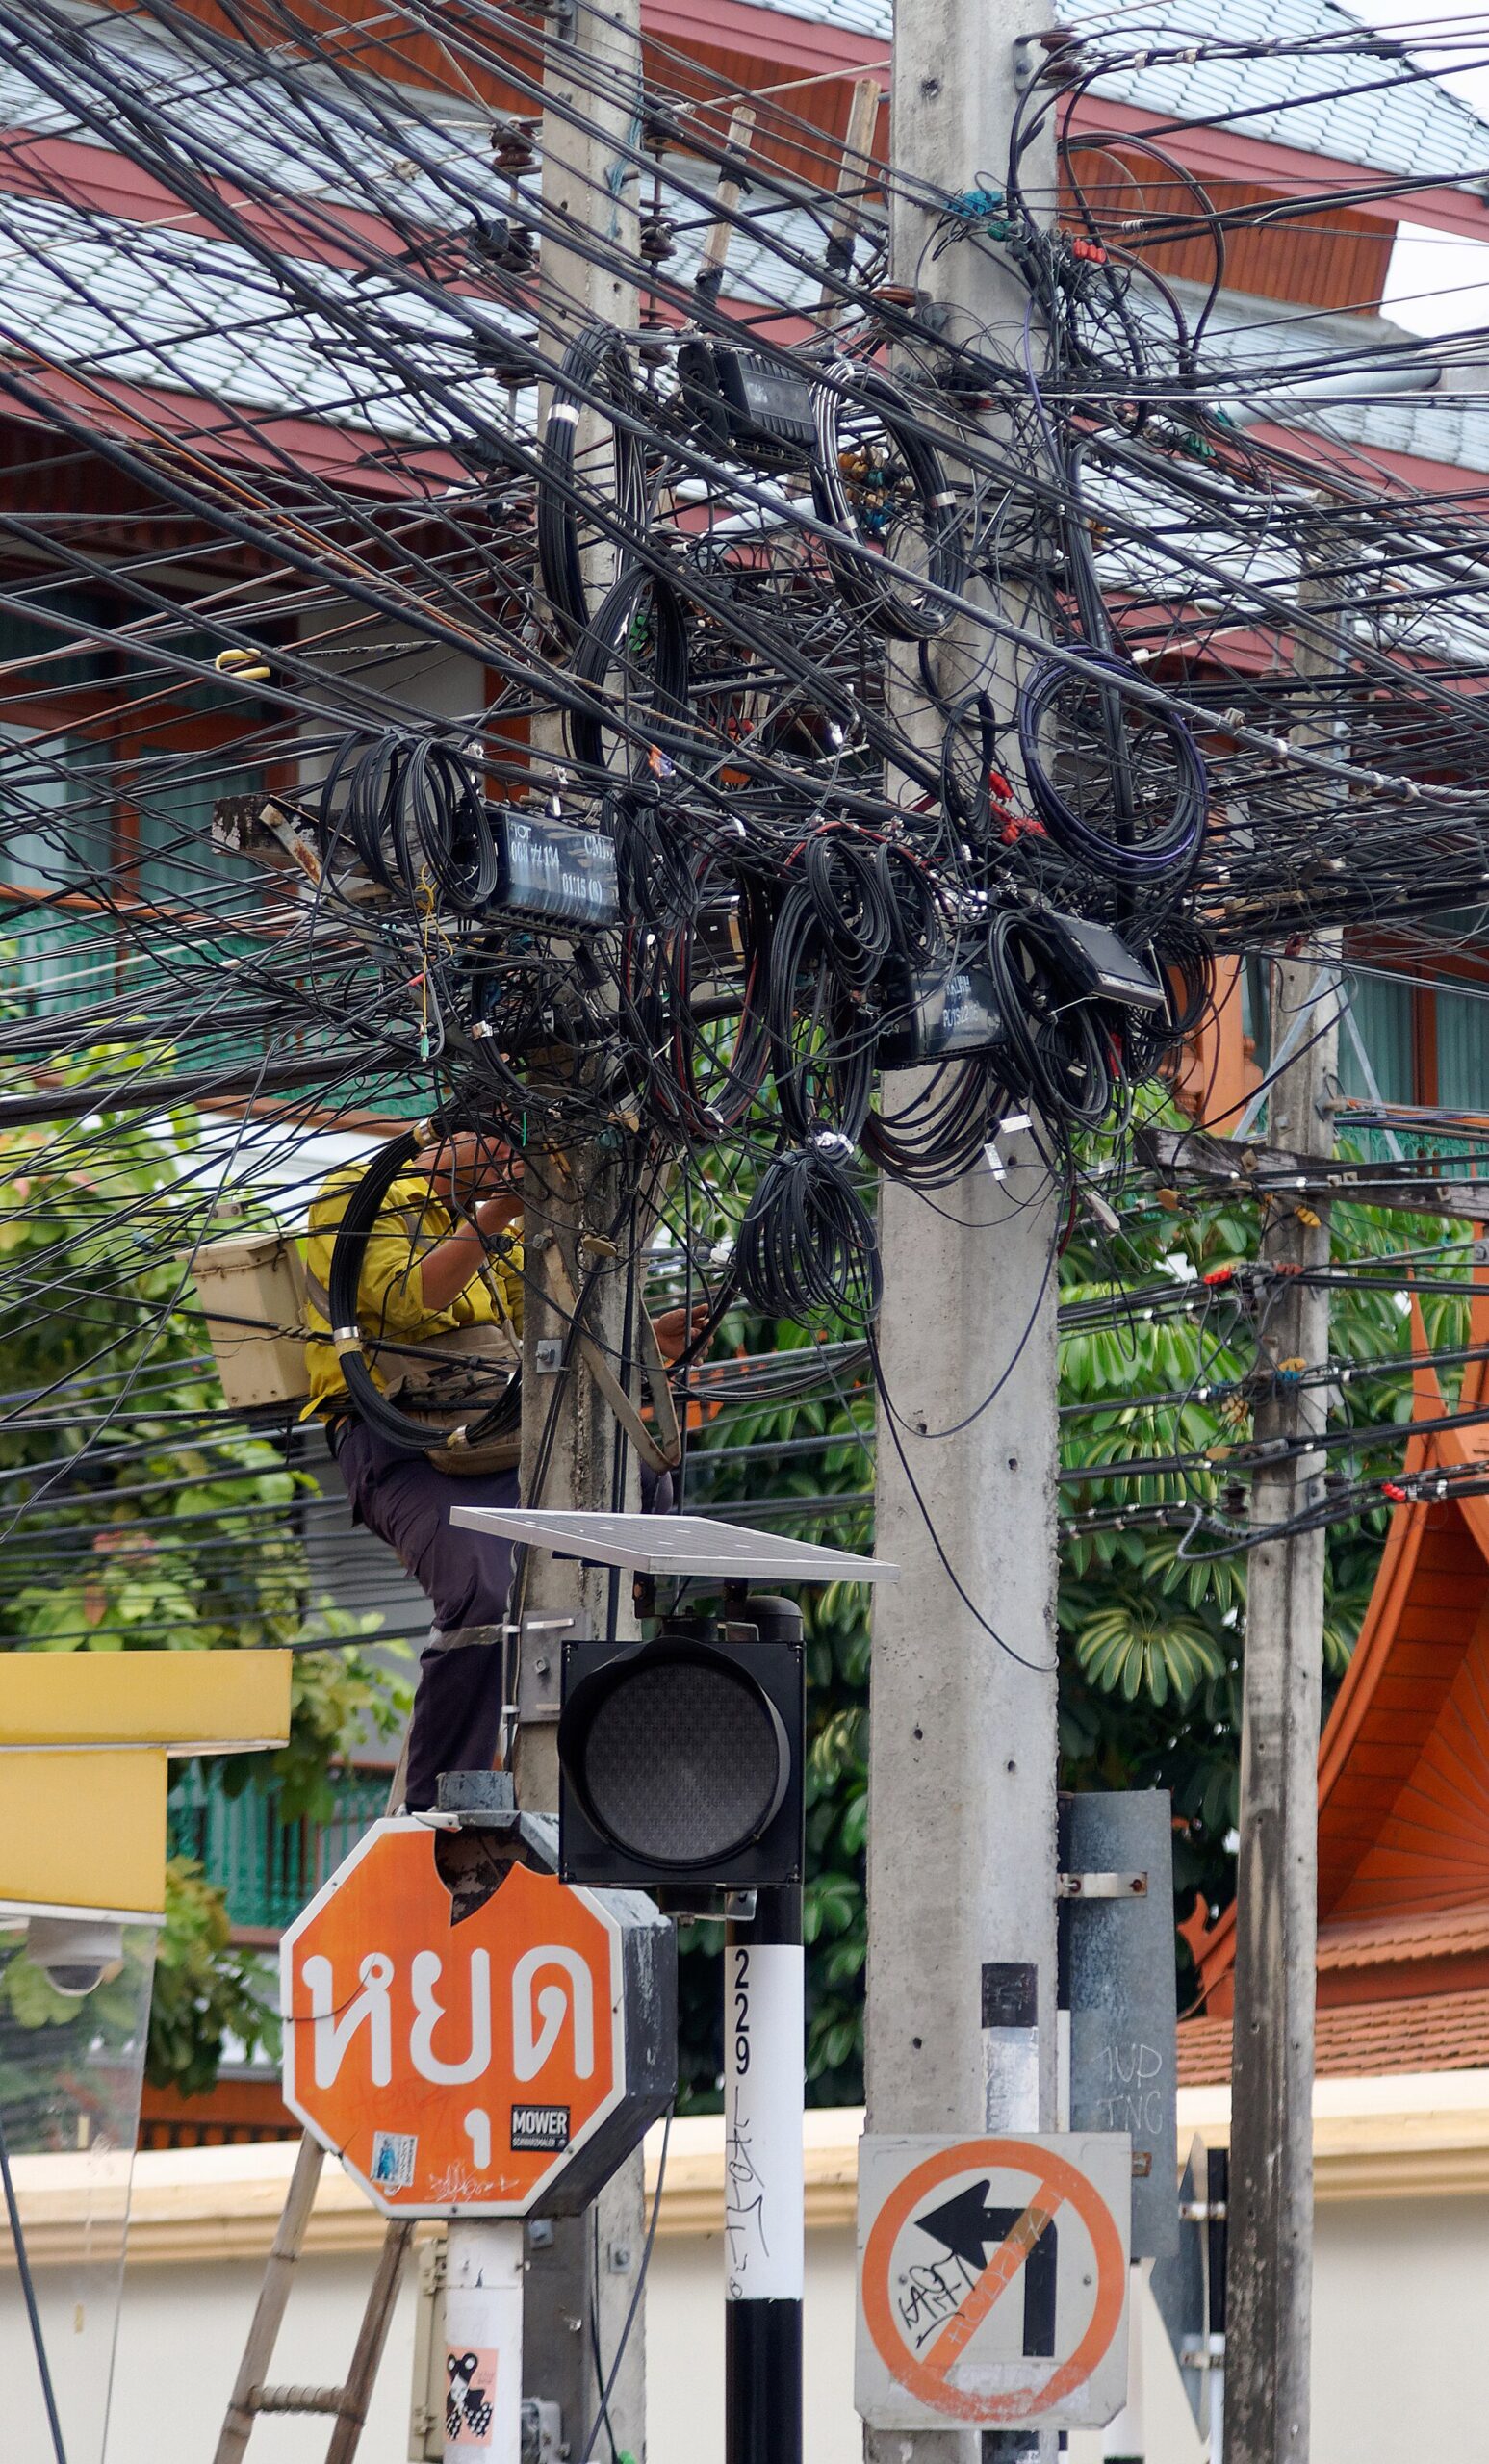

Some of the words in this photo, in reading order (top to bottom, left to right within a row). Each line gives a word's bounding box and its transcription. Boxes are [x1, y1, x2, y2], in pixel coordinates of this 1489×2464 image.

[301, 1944, 595, 2169] หยุด
[734, 1948, 750, 2076] 229
[512, 2110, 568, 2135] MOWER
